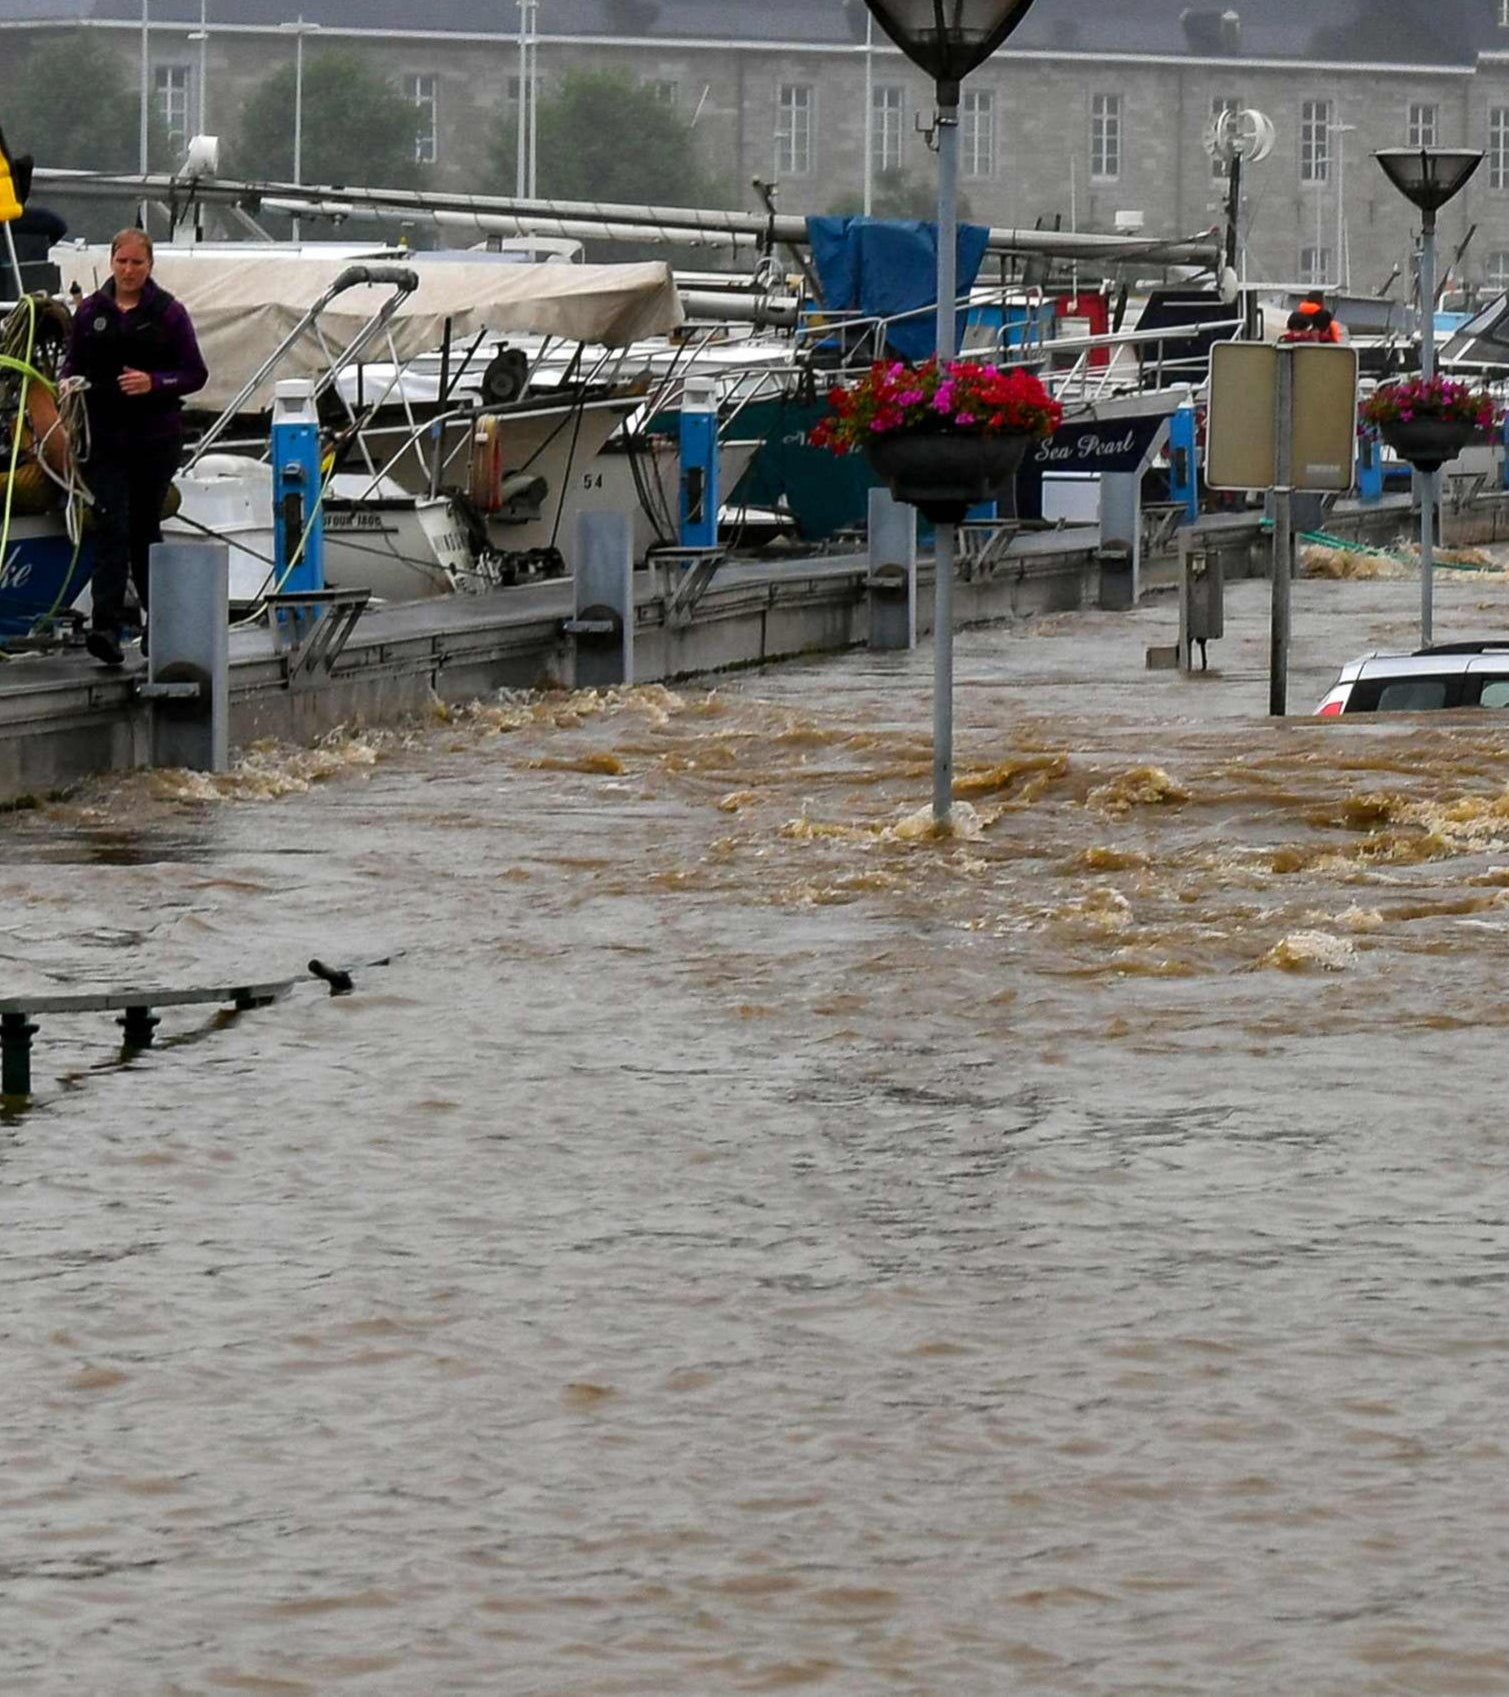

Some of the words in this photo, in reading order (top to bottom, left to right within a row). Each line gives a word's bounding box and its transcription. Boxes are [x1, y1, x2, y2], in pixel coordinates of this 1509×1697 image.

[1034, 435, 1073, 461] Sea
[1077, 429, 1135, 458] Pearl
[584, 474, 602, 489] 54
